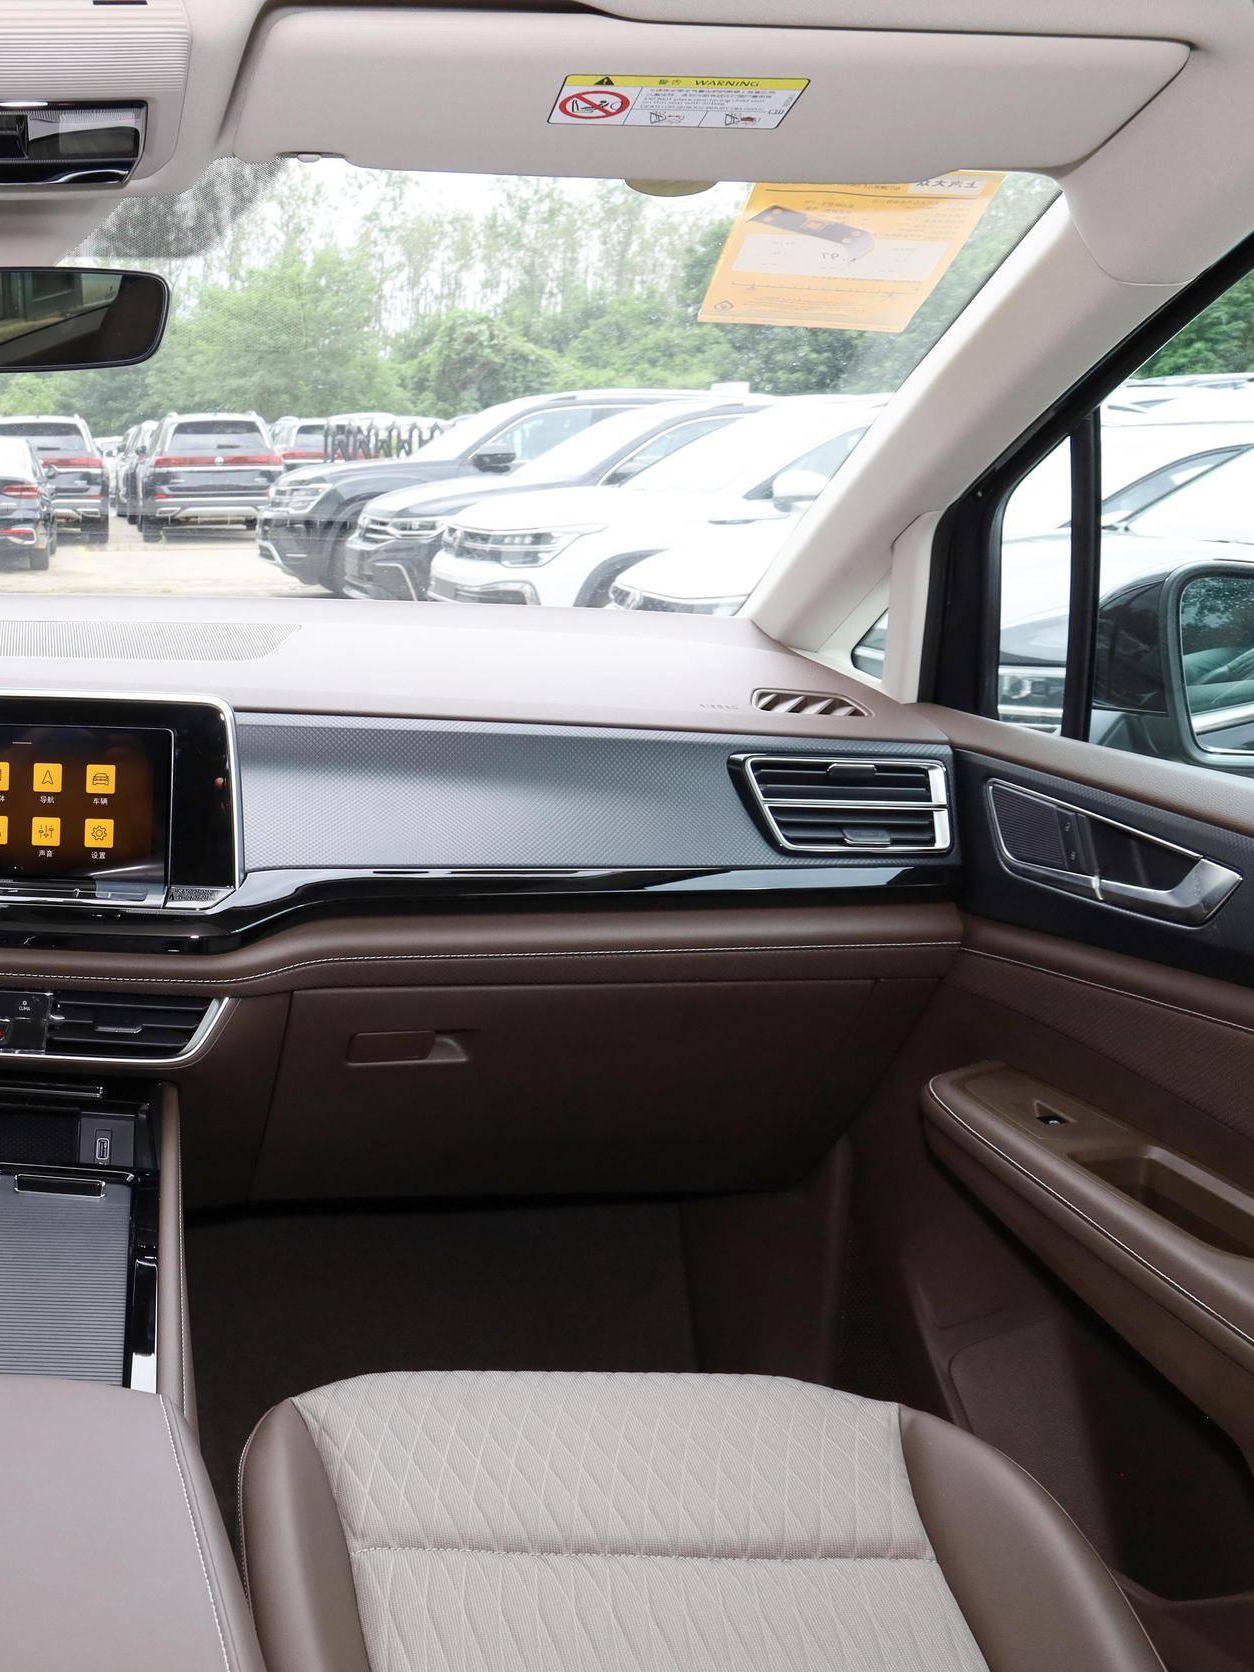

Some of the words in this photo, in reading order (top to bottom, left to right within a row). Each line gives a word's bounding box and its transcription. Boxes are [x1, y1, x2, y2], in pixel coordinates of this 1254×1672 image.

[695, 79, 760, 87] WARNING
[40, 796, 55, 804] 导航
[92, 798, 108, 806] 车辆
[37, 849, 53, 858] 声音
[91, 851, 106, 859] 设置
